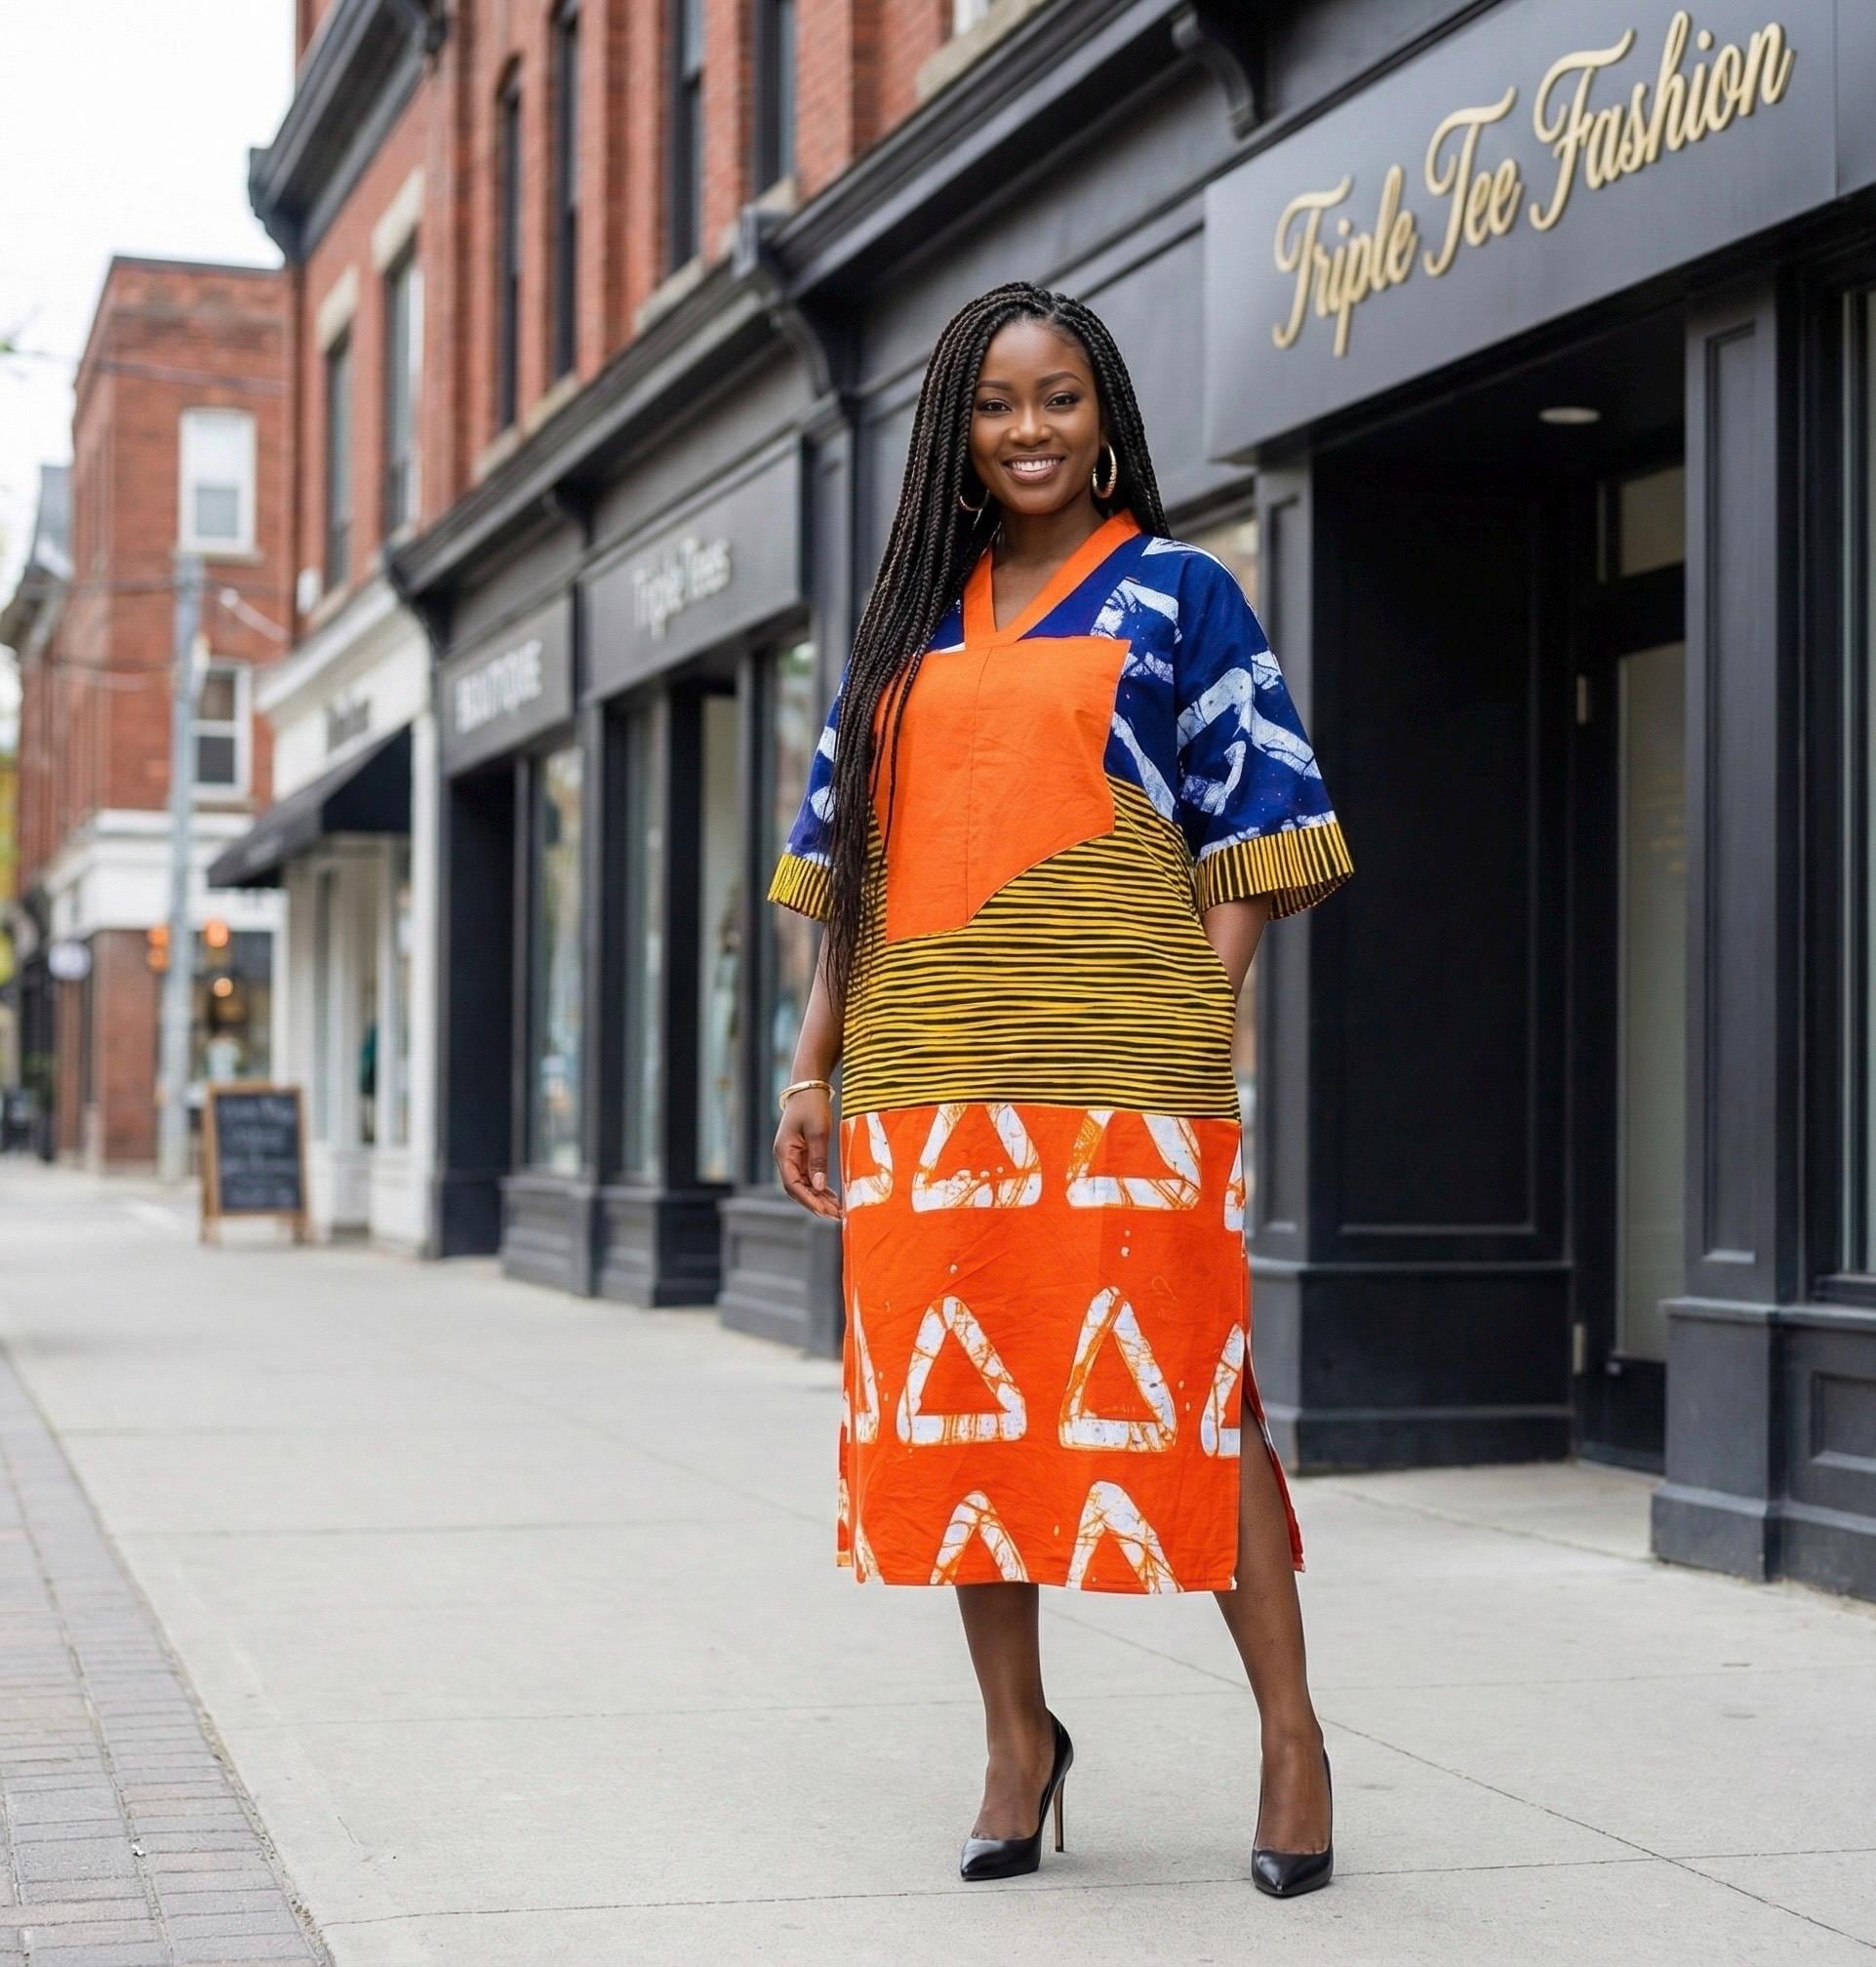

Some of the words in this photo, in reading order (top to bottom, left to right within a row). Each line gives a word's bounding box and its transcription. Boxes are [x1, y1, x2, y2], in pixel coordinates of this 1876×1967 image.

[1272, 164, 1417, 358] Triple
[1423, 85, 1522, 277] Tee
[1529, 10, 1796, 232] Fashion
